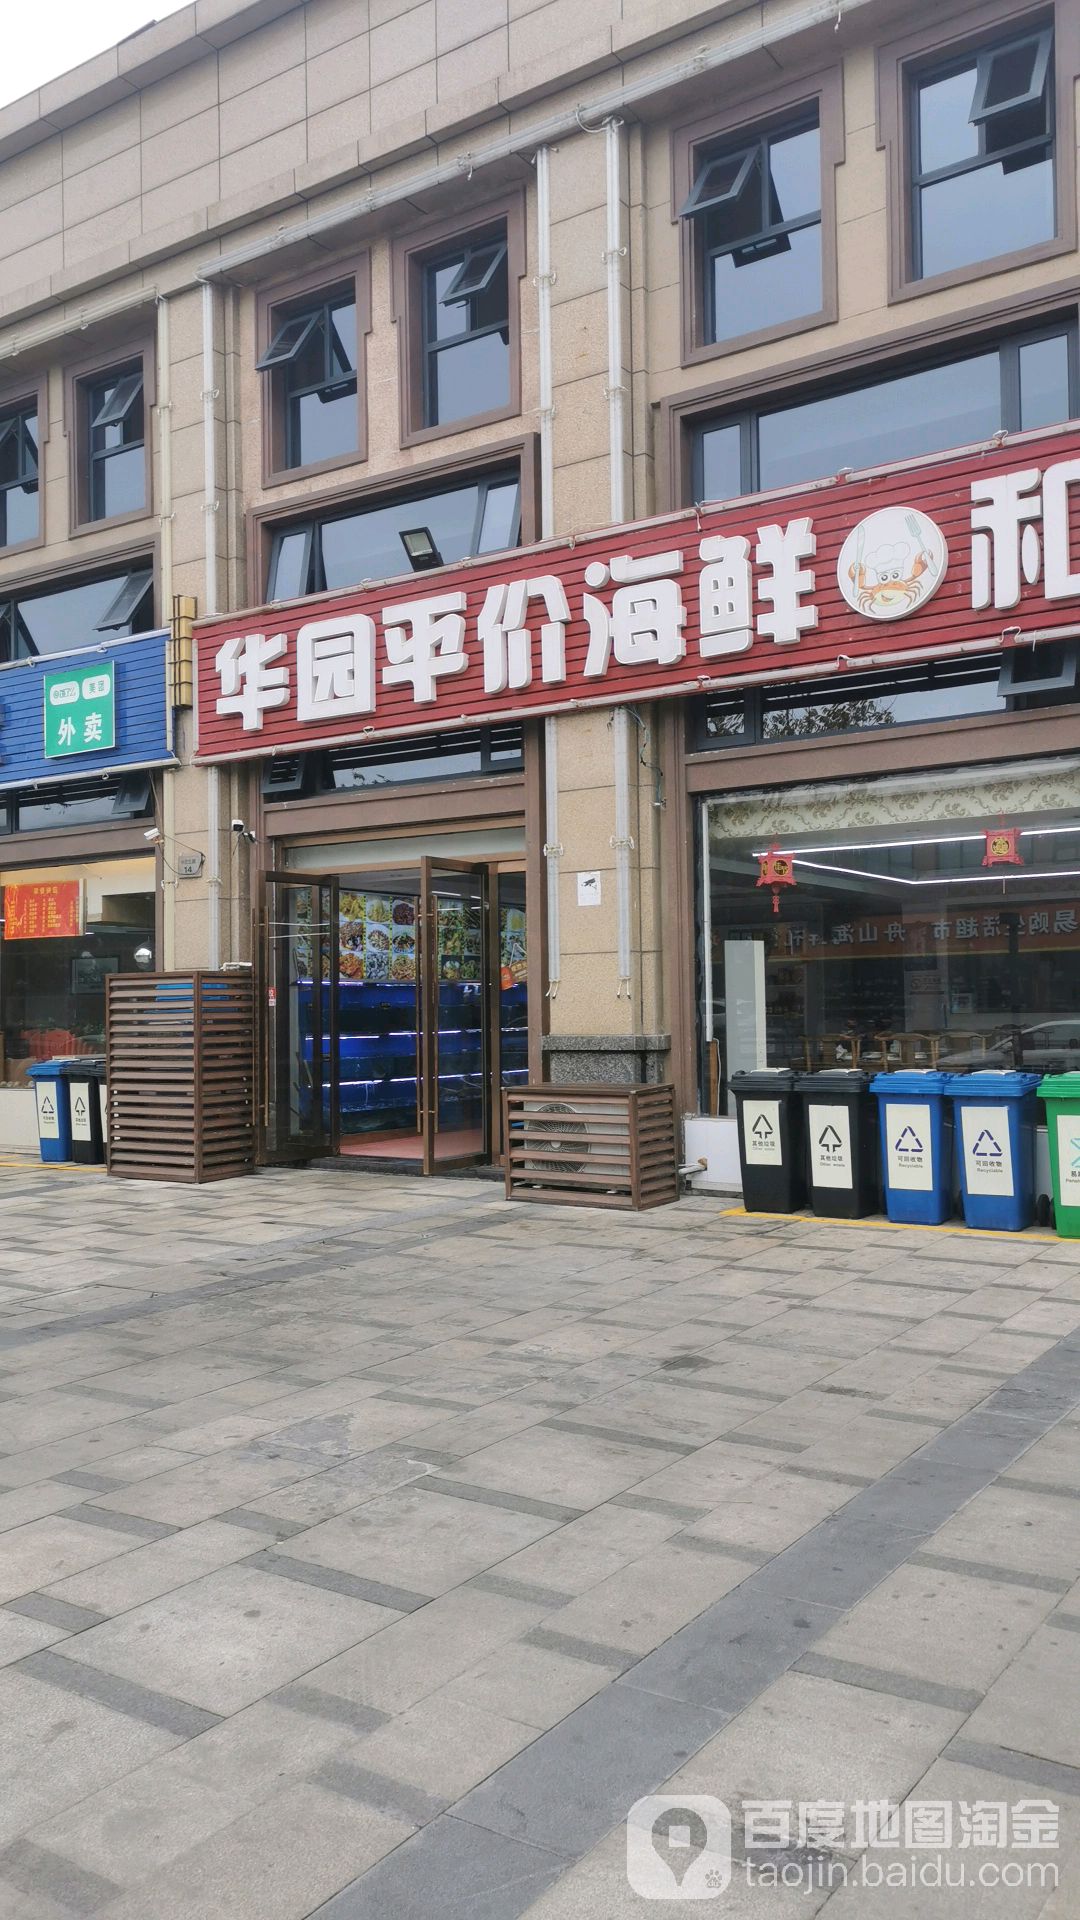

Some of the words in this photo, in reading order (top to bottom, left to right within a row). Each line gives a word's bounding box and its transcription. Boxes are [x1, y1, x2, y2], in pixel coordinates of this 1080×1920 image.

[215, 516, 819, 732] 华园平价海鲜
[57, 712, 103, 746] 外卖
[897, 1155, 923, 1163] 可回收物
[975, 1160, 1003, 1168] 可回收物
